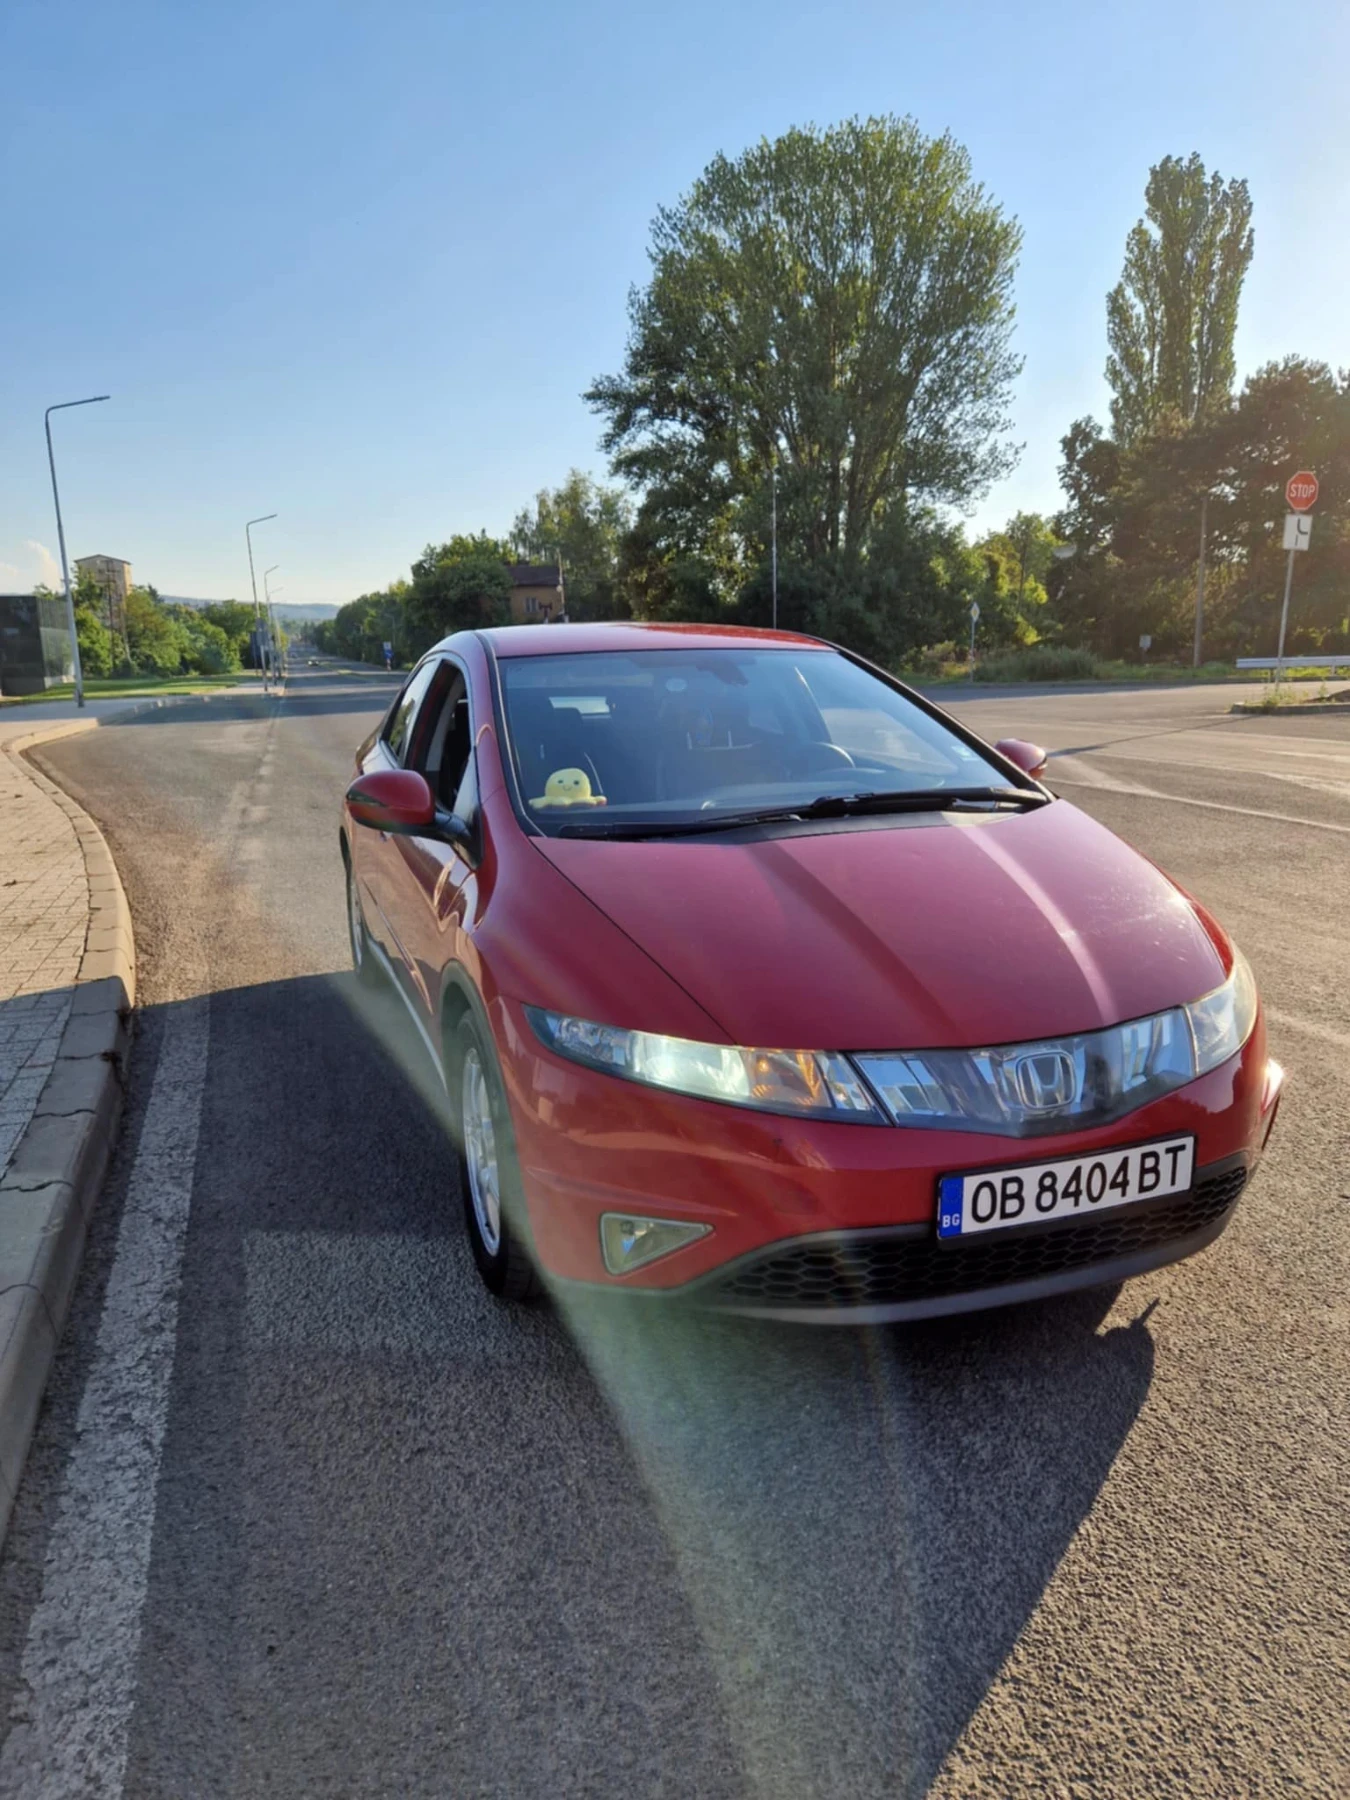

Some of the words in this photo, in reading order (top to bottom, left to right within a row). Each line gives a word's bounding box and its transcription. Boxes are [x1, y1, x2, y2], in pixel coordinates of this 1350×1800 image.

[1290, 484, 1316, 498] STOP
[971, 1176, 1025, 1223] OB
[1035, 1156, 1130, 1213] 8404
[1138, 1144, 1186, 1193] BT
[942, 1213, 960, 1228] BG
